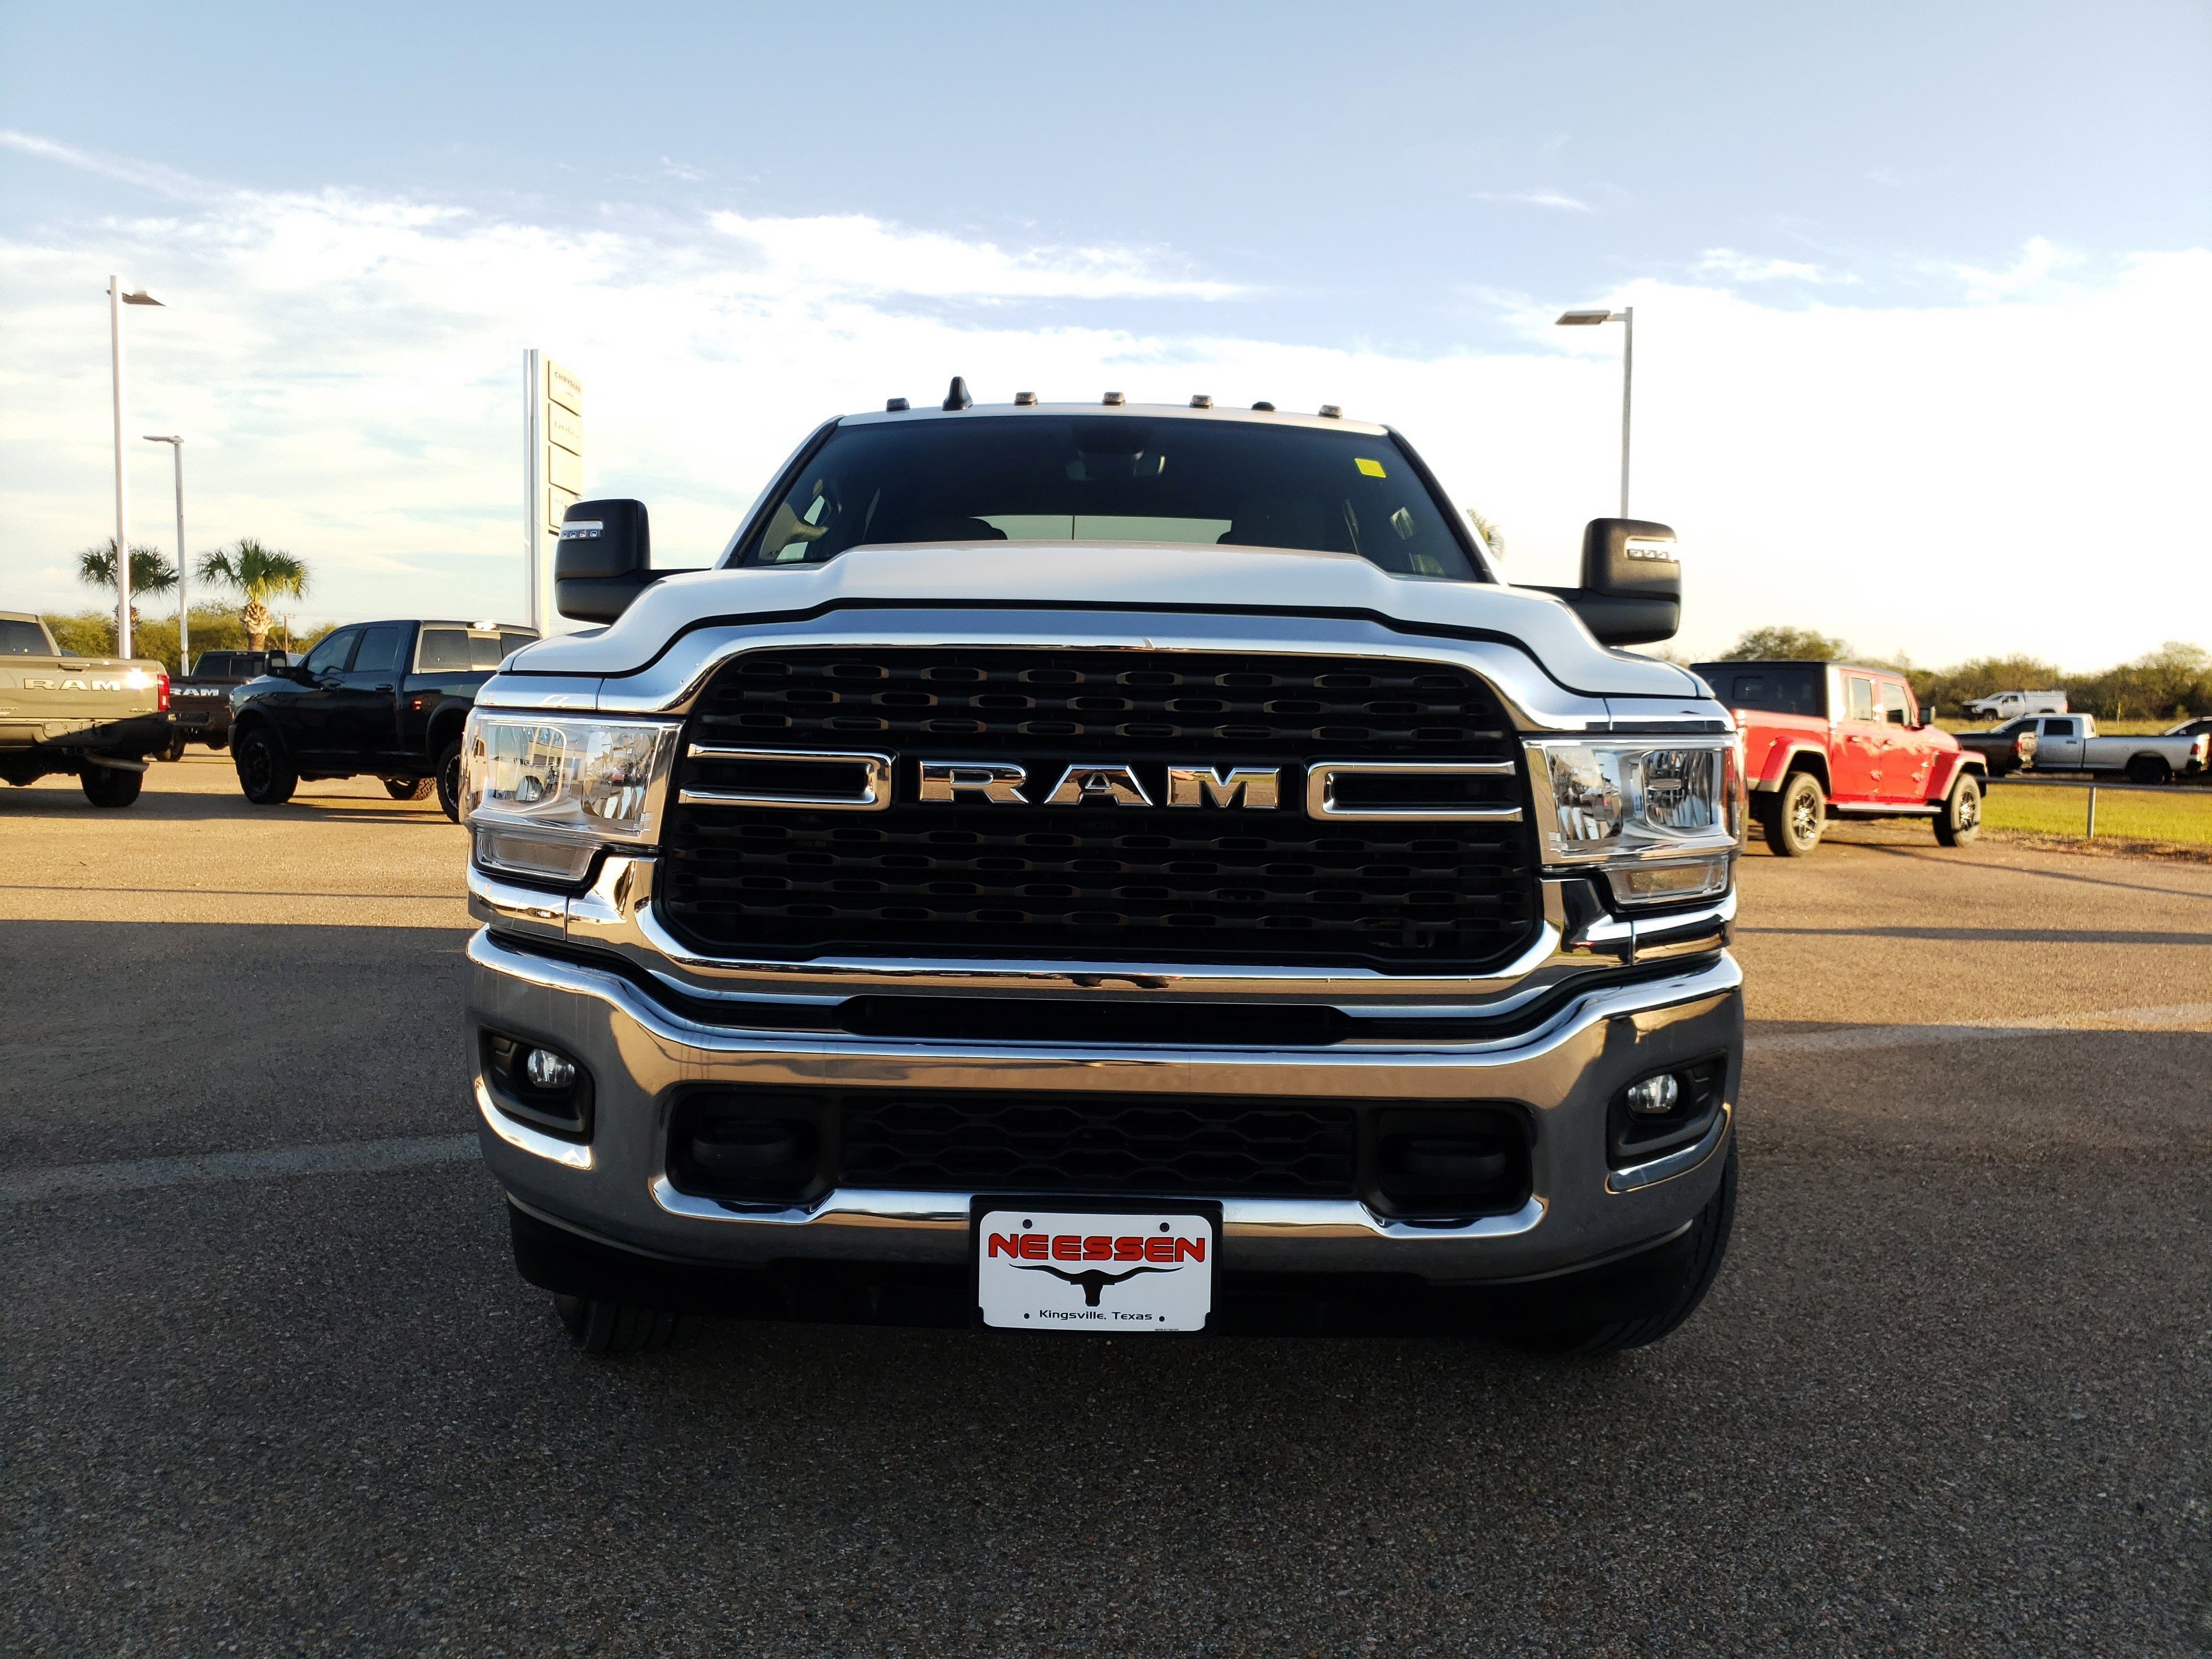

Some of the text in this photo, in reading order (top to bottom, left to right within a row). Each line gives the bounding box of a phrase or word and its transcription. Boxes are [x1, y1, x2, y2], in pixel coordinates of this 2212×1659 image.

[555, 371, 580, 393] CHRYSLER
[24, 678, 121, 691] RAM
[918, 760, 1280, 810] RAM
[988, 1232, 1206, 1263] NEESSEN
[1039, 1310, 1153, 1321] Kingsville, Texas
